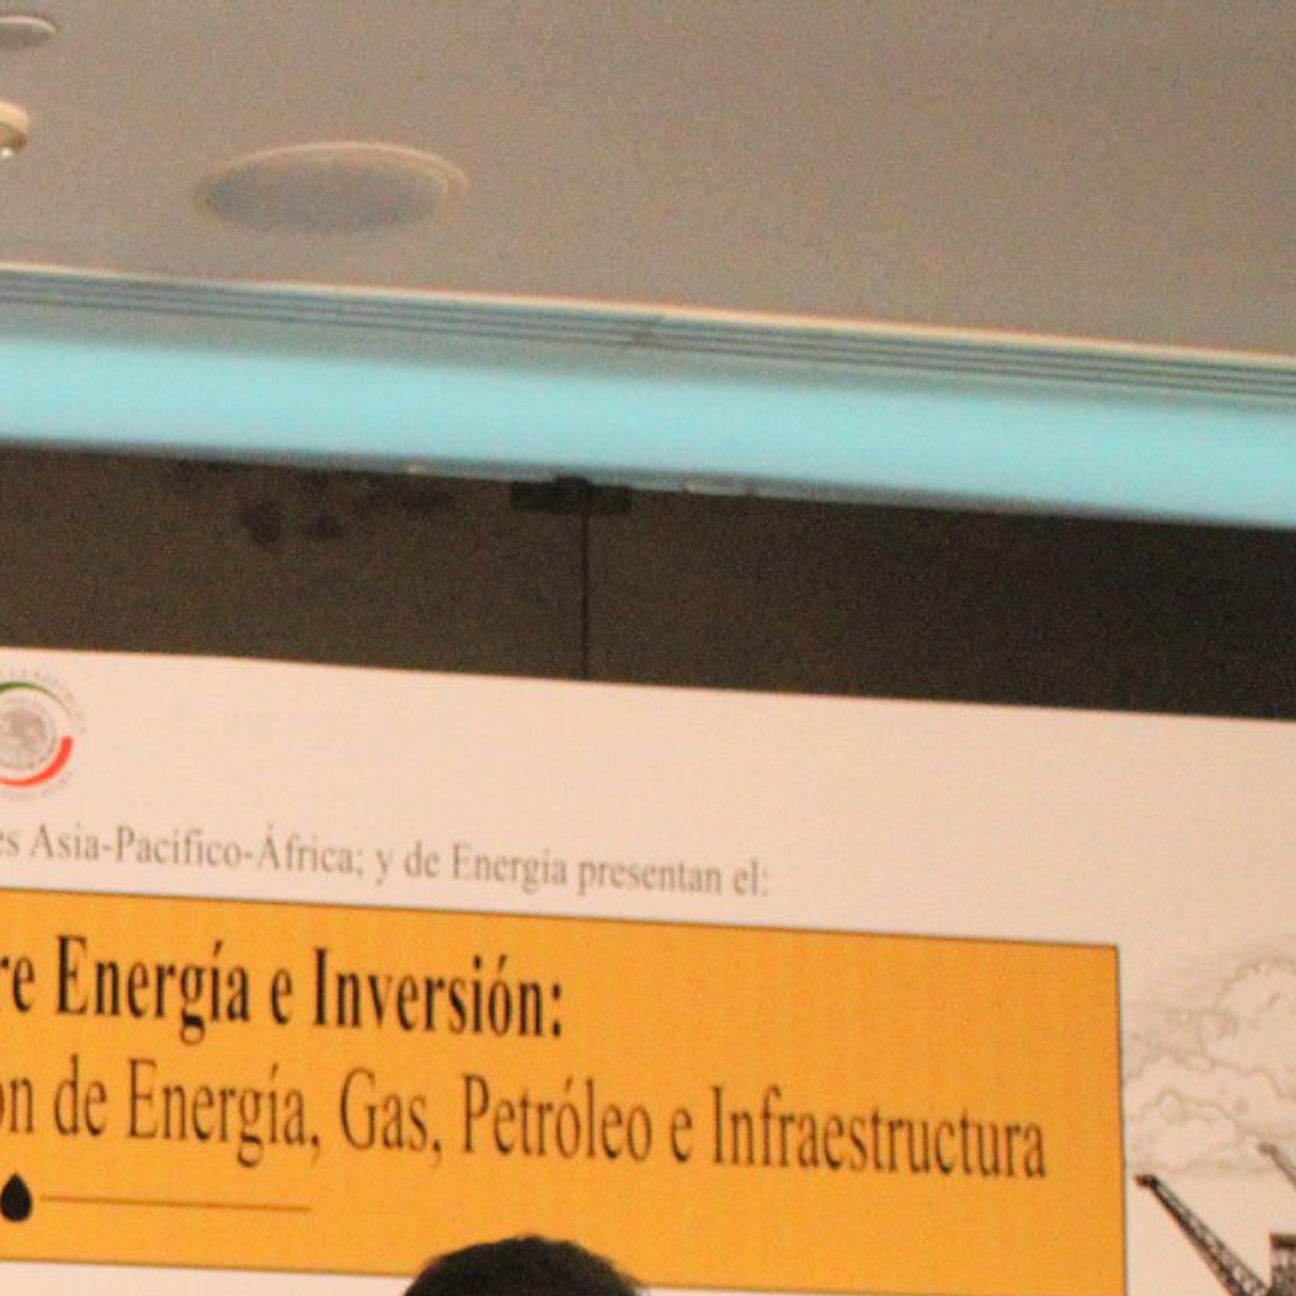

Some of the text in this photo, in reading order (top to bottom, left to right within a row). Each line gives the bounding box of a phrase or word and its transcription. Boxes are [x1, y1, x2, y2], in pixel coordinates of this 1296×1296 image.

[375, 849, 393, 887] y
[403, 840, 441, 879] de
[578, 860, 723, 897] presentan
[56, 934, 250, 1045] Energía
[270, 969, 293, 1026] e
[314, 947, 562, 1038] Inversión:
[53, 1053, 108, 1138] de
[127, 1057, 320, 1169] Energía,
[339, 1065, 443, 1168] Gas,
[462, 1072, 653, 1162] Petróleo
[669, 1109, 693, 1164] e
[711, 1084, 1047, 1179] Infraestructura
